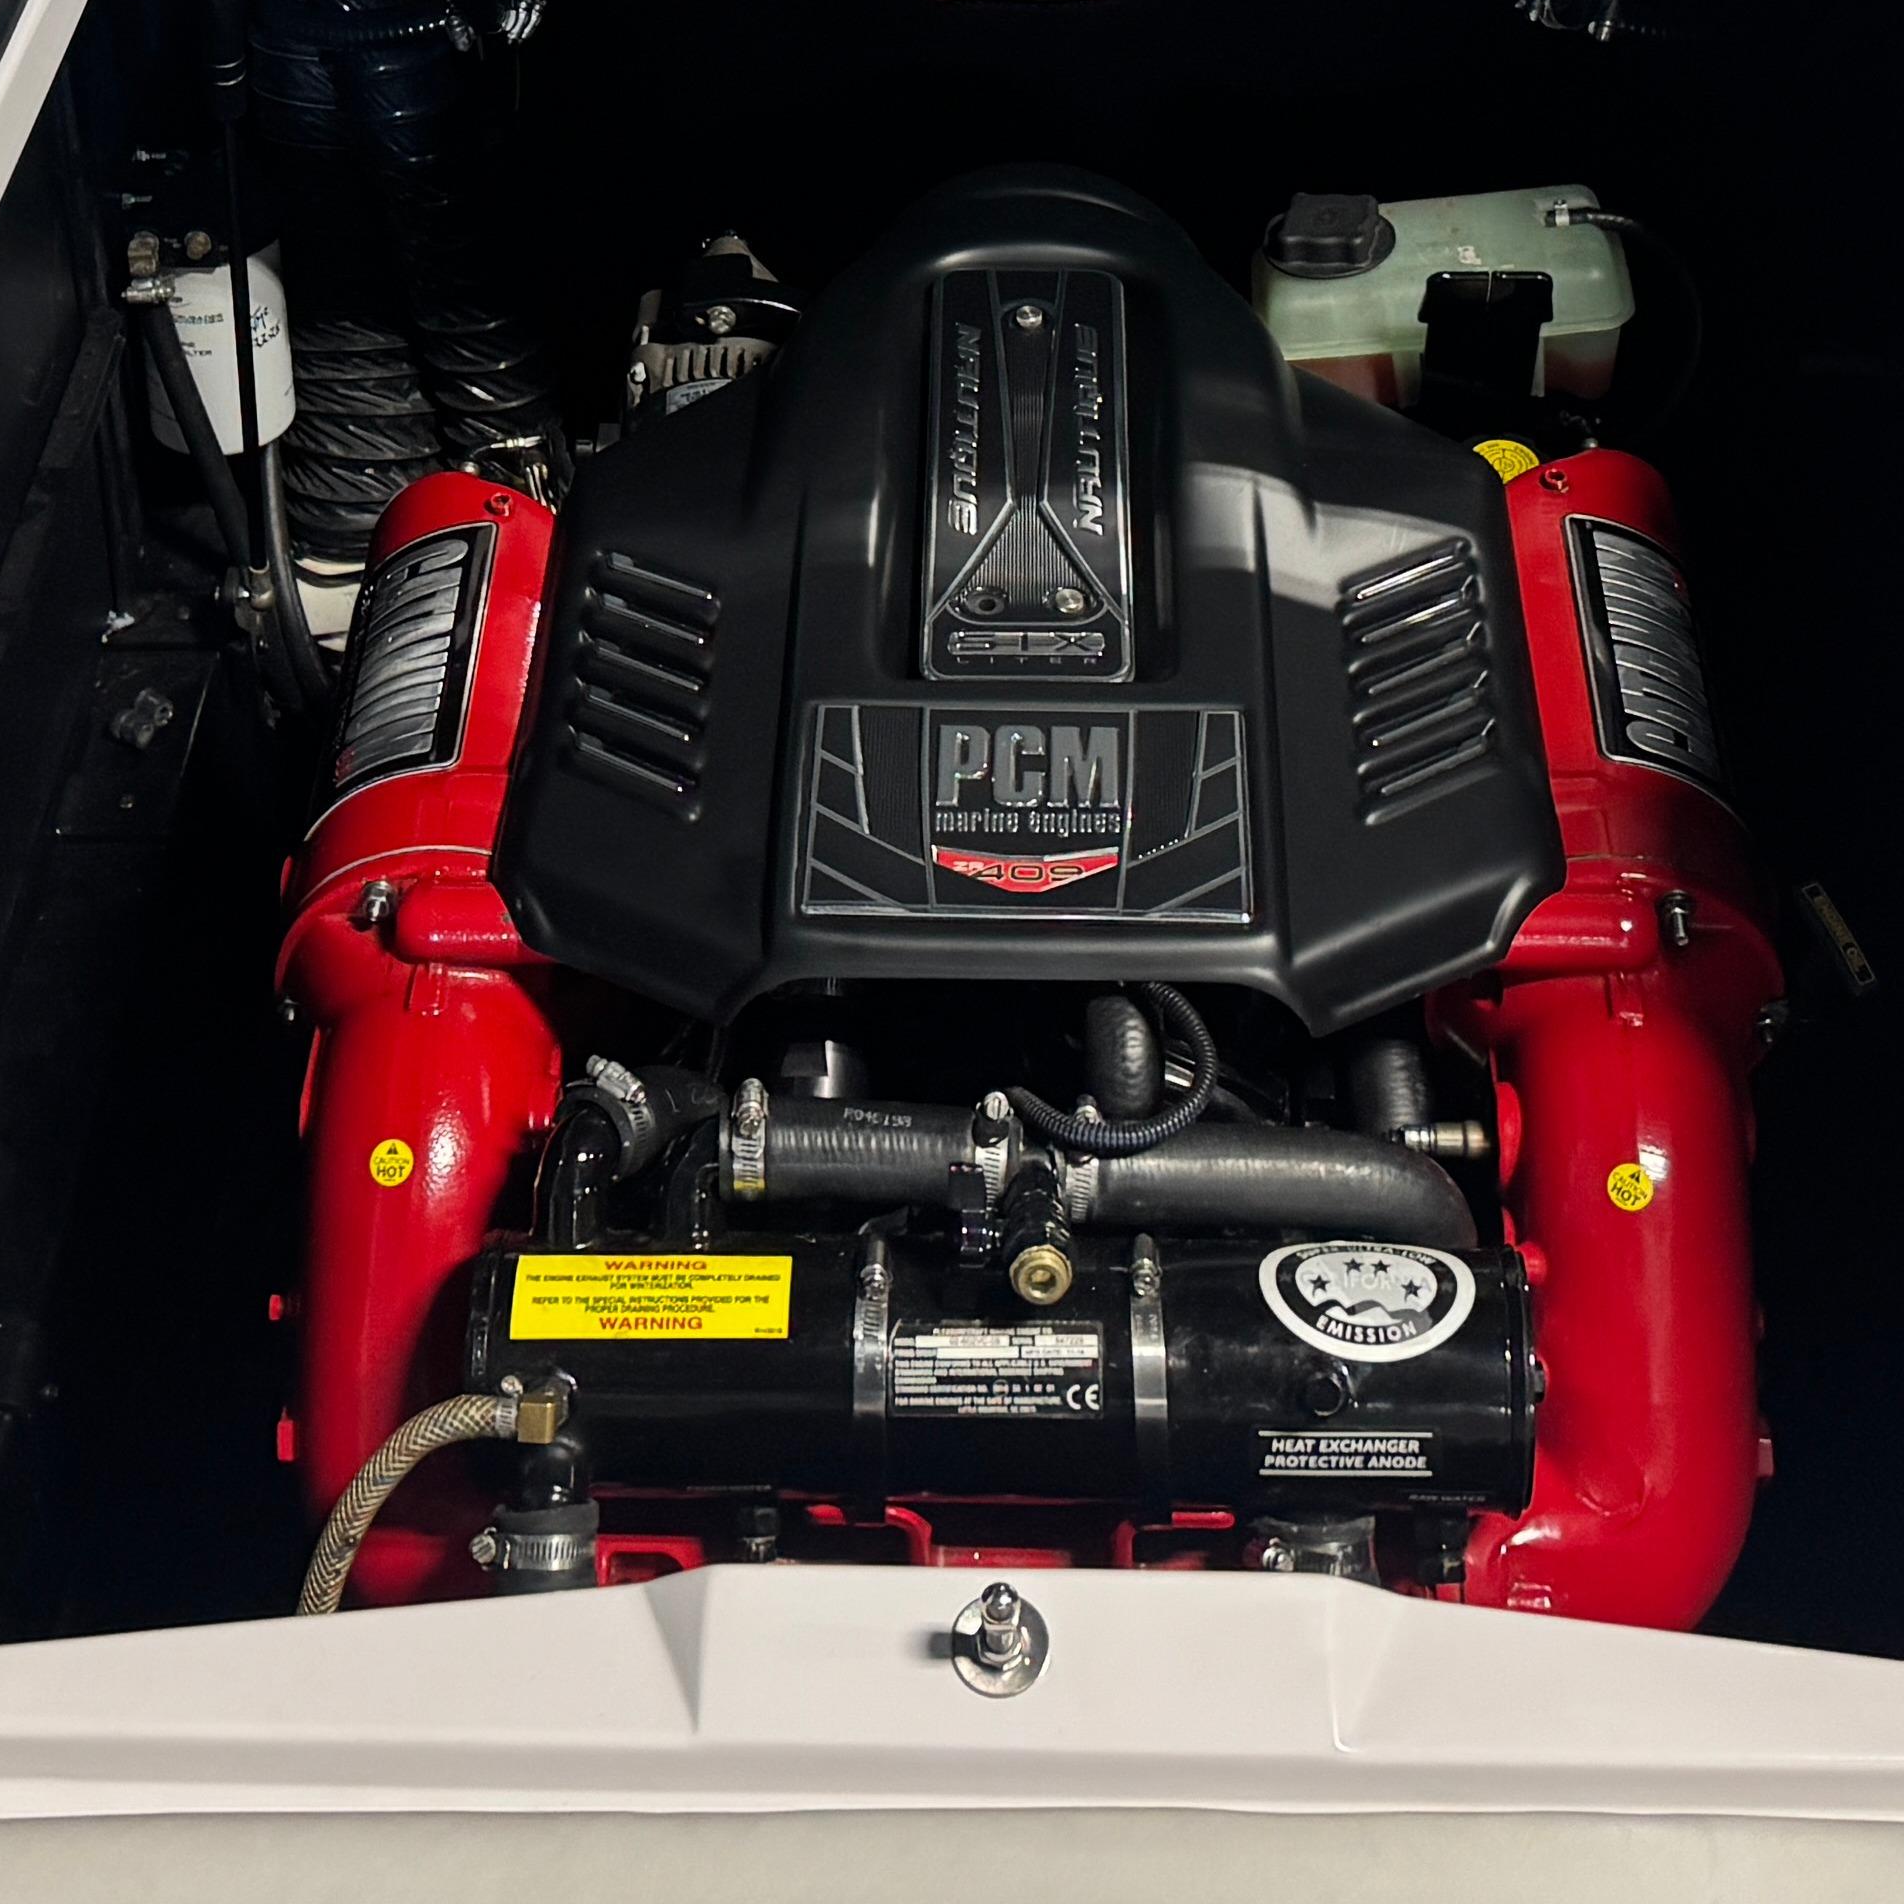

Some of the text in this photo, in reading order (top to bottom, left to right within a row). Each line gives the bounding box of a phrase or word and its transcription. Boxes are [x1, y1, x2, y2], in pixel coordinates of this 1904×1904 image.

[947, 321, 982, 536] NAUTIQUE
[1073, 322, 1105, 536] NAUTIQUE
[947, 632, 1105, 656] SIX
[957, 656, 1097, 665] LITER
[935, 724, 1121, 808] PCM
[935, 809, 1121, 837] marine engines
[970, 863, 1086, 882] 409
[377, 1165, 405, 1178] HOT
[1611, 1182, 1641, 1206] HOT
[605, 1261, 707, 1271] WARNING
[562, 1295, 573, 1304] TO
[599, 1317, 703, 1330] WARNING
[1316, 1314, 1417, 1343] EMISSION
[1066, 1384, 1100, 1410] CE
[1271, 1438, 1420, 1454] HEAT EXCHANGER
[1264, 1455, 1427, 1469] PROTECTIVE ANODE
